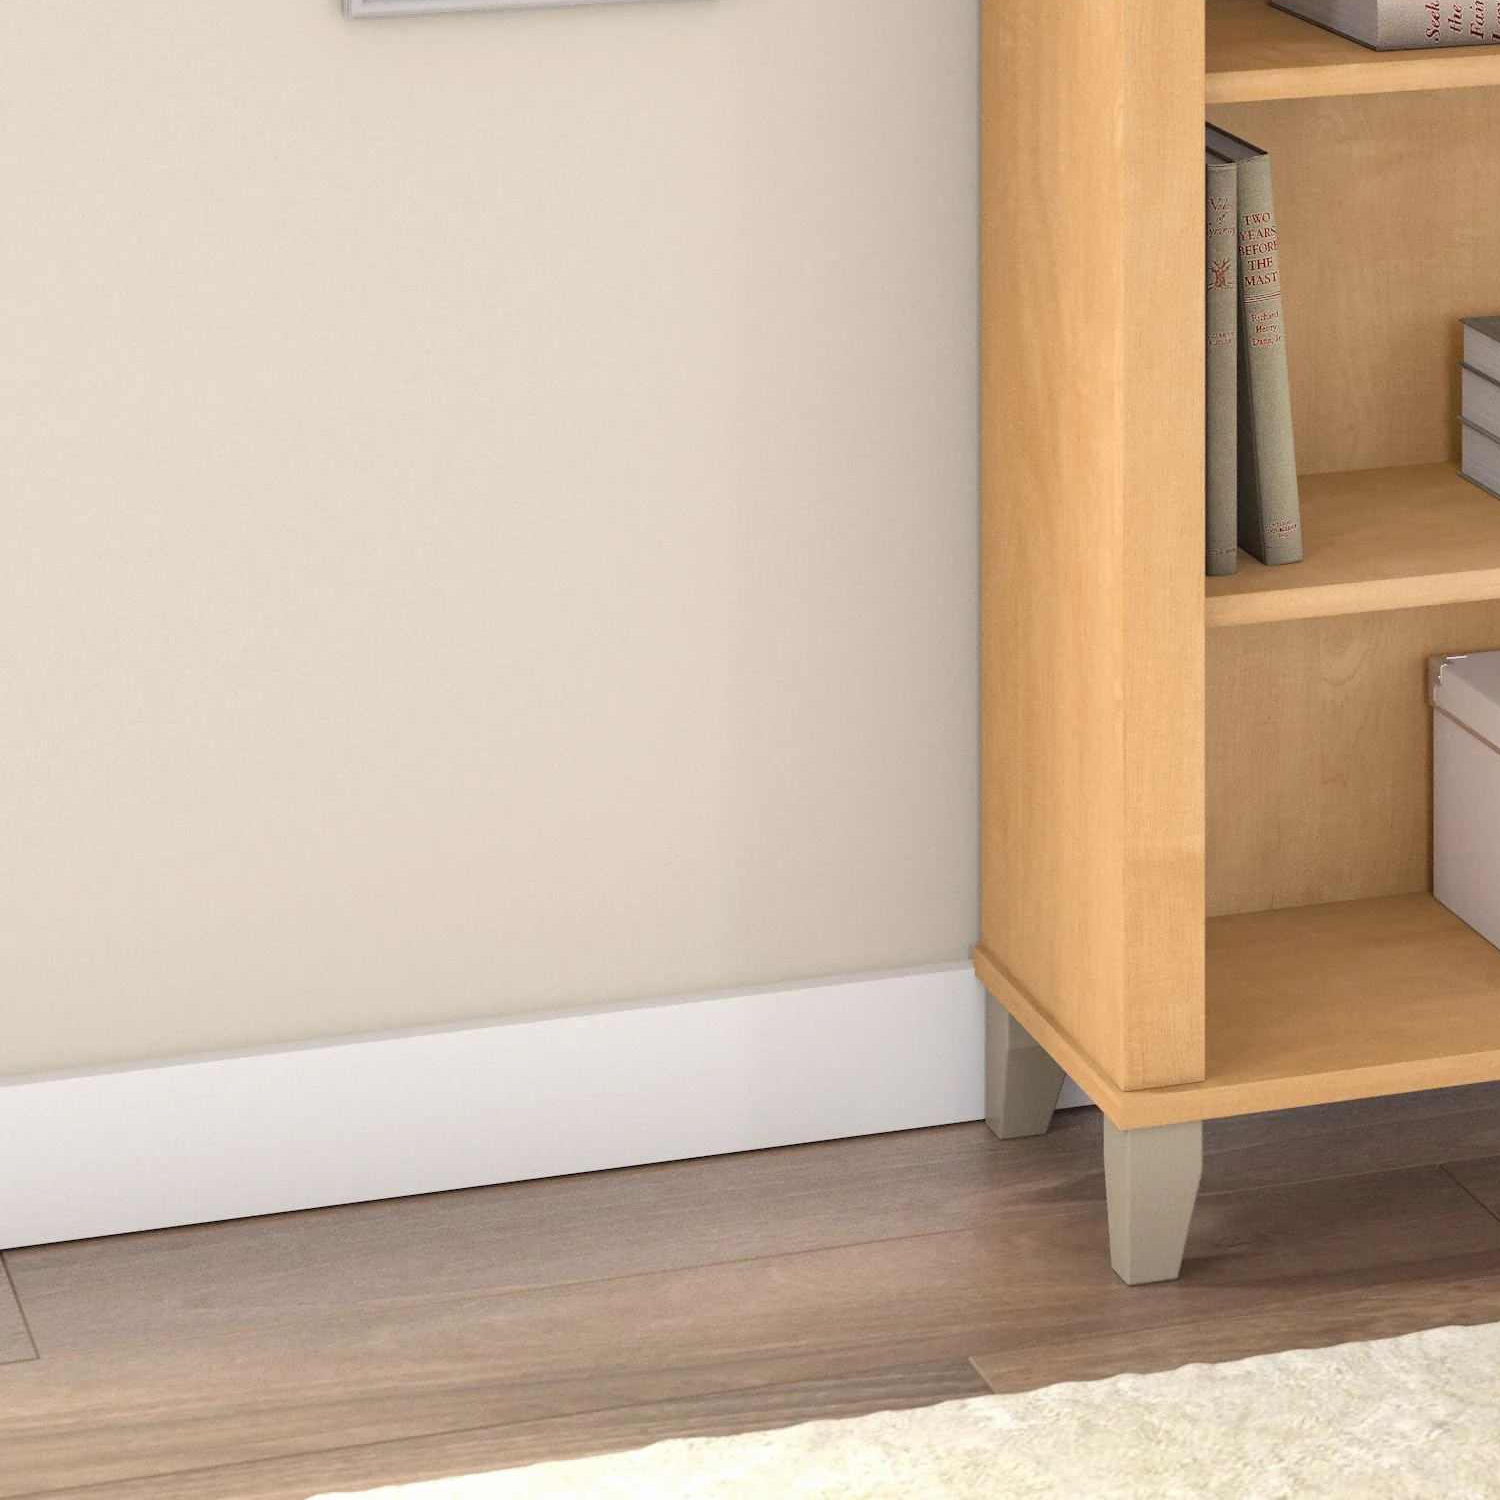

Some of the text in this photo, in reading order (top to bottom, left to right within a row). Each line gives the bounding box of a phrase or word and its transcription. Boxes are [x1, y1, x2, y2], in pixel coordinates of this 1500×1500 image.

[1425, 0, 1440, 41] Seek
[1447, 4, 1463, 32] the
[1242, 212, 1271, 226] TWO
[1239, 225, 1277, 241] YEARS
[1247, 257, 1274, 271] THE
[1244, 271, 1278, 287] MAST
[1255, 325, 1278, 334] Henry
